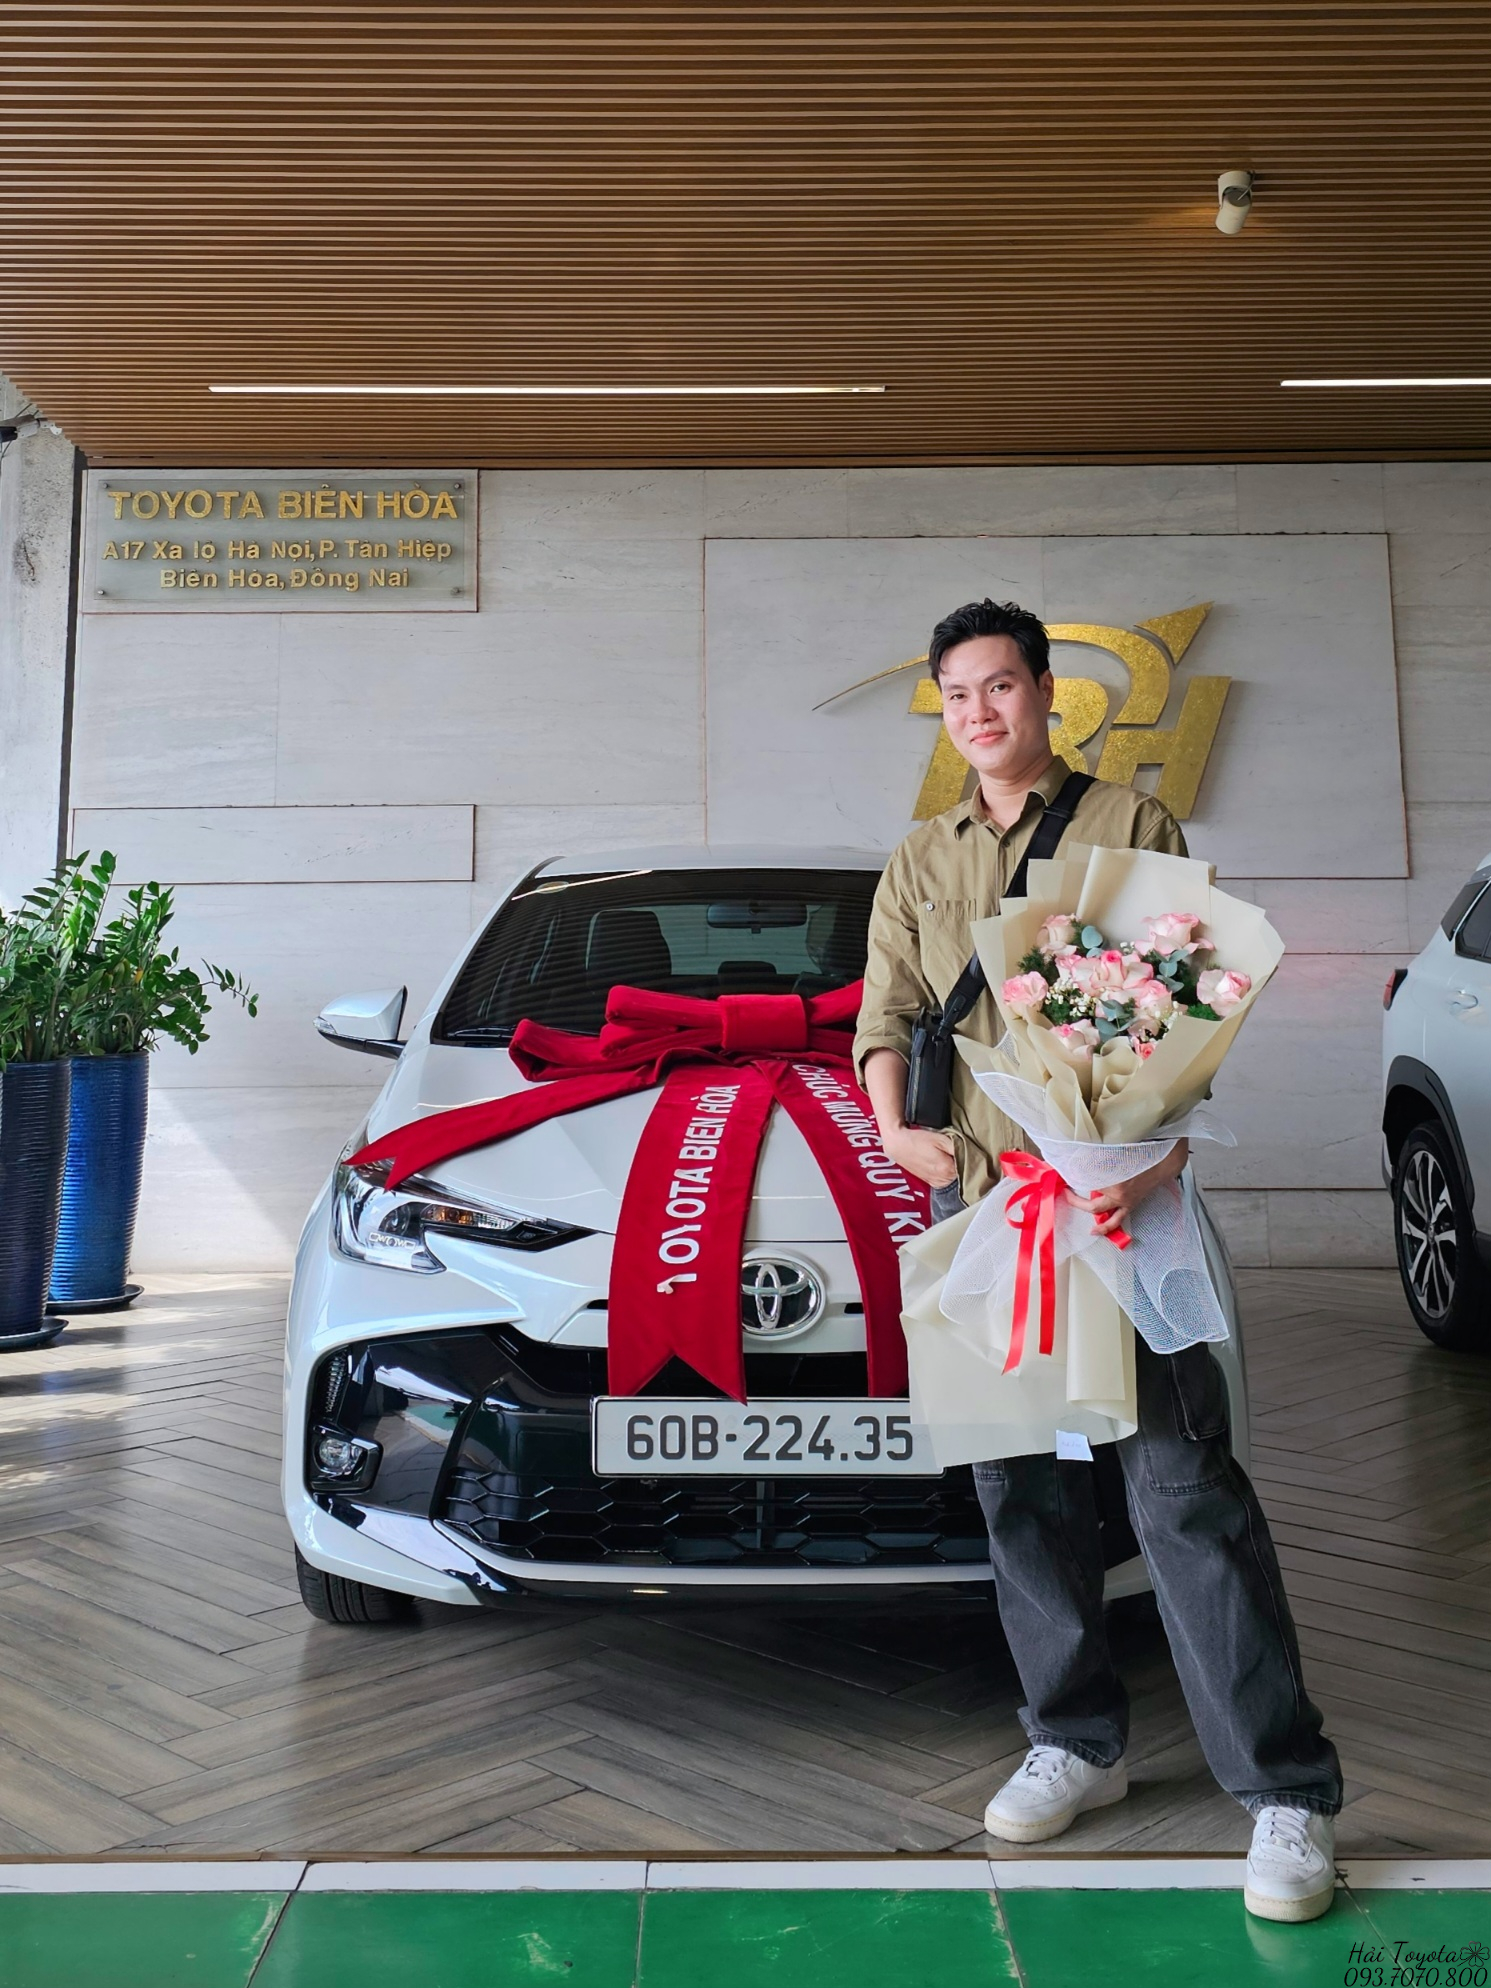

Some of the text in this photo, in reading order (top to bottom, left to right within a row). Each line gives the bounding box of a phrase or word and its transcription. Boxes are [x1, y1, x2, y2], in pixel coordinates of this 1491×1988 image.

[108, 482, 458, 520] TOYOTA BIÊN HÒA
[102, 540, 146, 560] A17
[152, 540, 183, 560] Xa
[397, 538, 452, 562] Hiệp
[369, 568, 409, 588] Nai
[690, 1084, 741, 1114] HÒA
[792, 1064, 851, 1099] CHÚC
[858, 1151, 925, 1202] QUÝ
[626, 1414, 914, 1461] 60B-224.35
